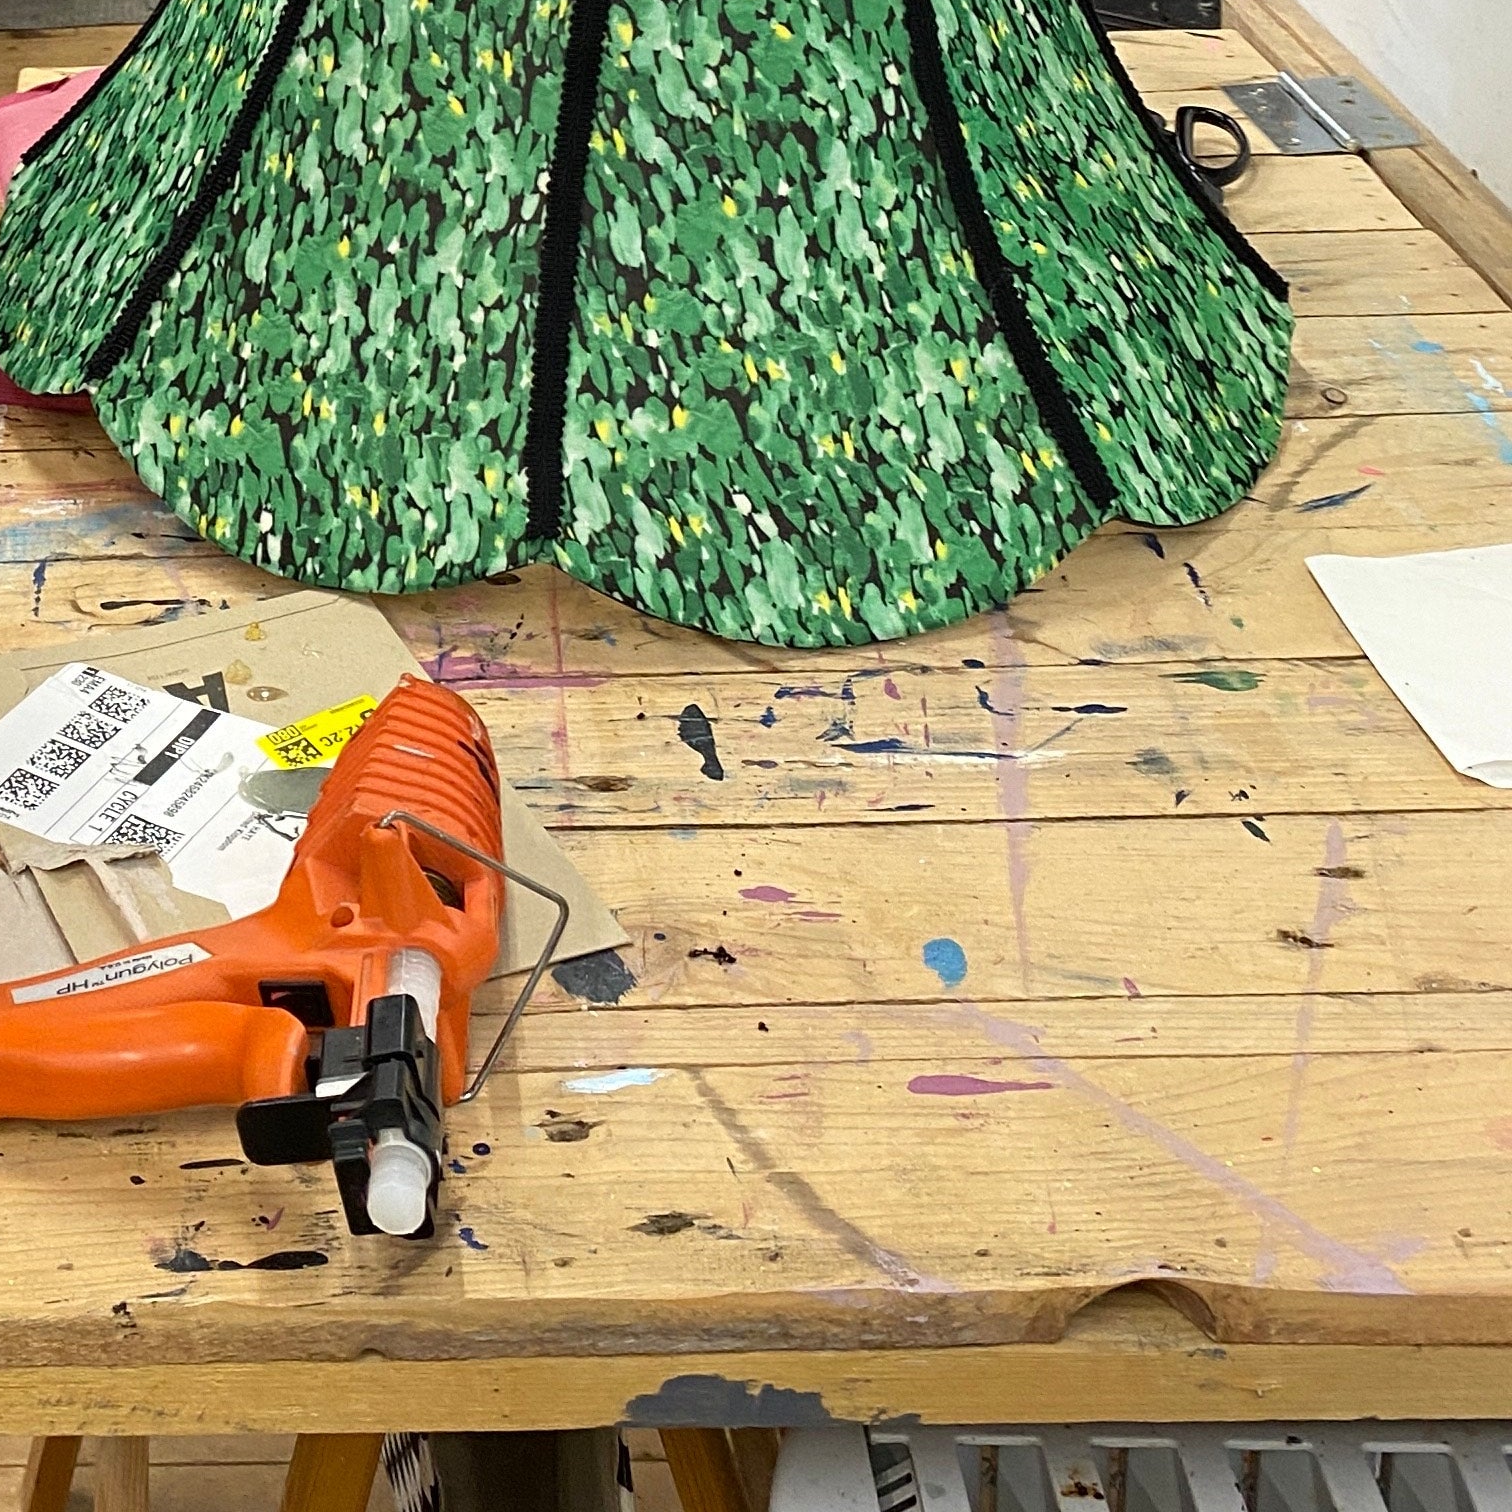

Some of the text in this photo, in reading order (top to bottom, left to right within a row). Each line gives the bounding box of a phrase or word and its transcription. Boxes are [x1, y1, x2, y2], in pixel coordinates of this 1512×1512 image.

[268, 725, 300, 744] 080
[88, 790, 138, 832] CYCLE 1
[56, 979, 88, 995] HP
